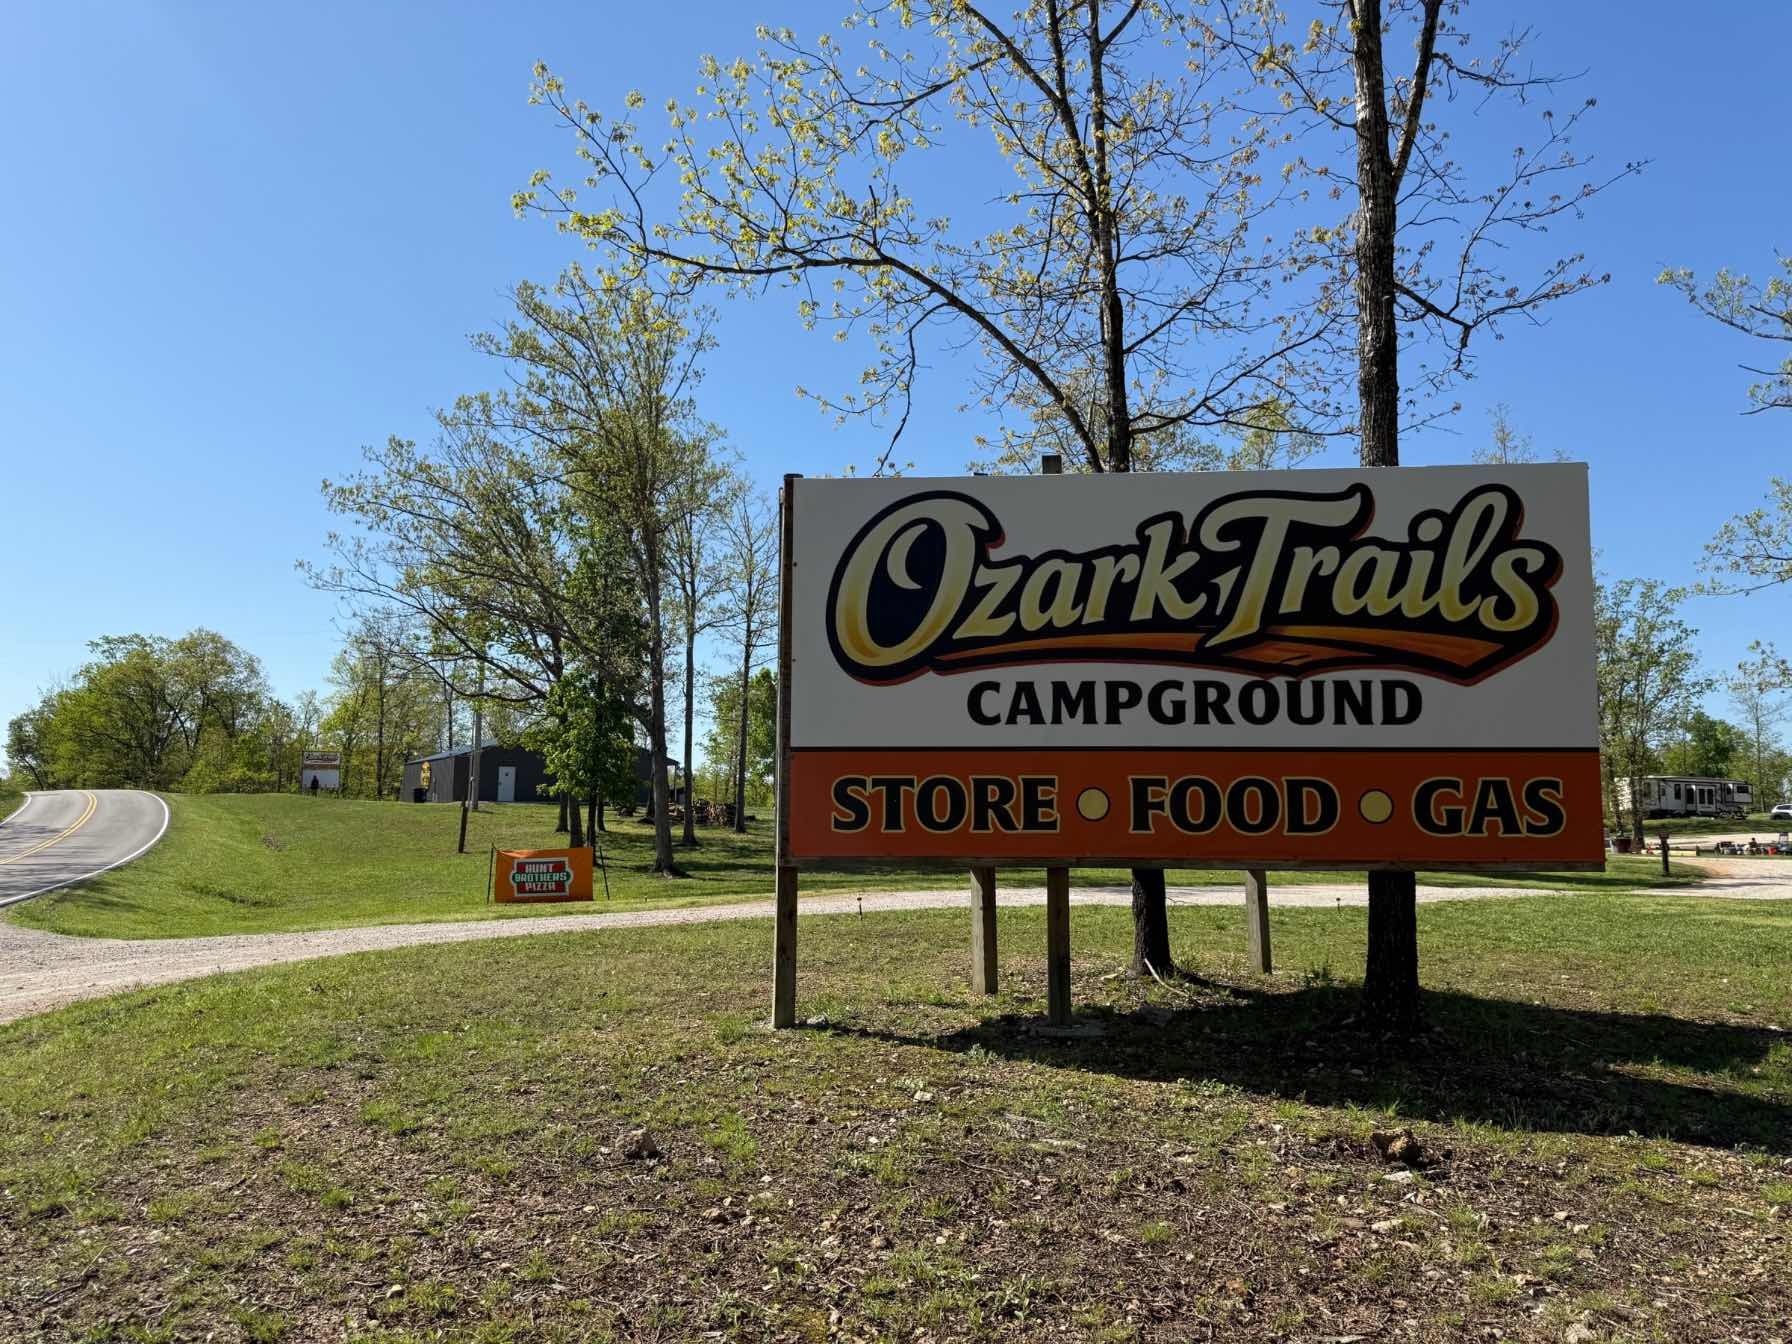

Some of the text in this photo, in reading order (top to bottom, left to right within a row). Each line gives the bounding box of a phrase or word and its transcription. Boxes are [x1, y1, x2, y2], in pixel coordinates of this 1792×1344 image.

[833, 489, 1546, 667] Ozark Trails
[966, 679, 1423, 726] CAMPGROUND
[831, 774, 1566, 838] STORE FOOD GAS
[514, 872, 568, 882] BROTHERS
[525, 863, 555, 873] HUNT
[525, 882, 556, 892] PIZZA
